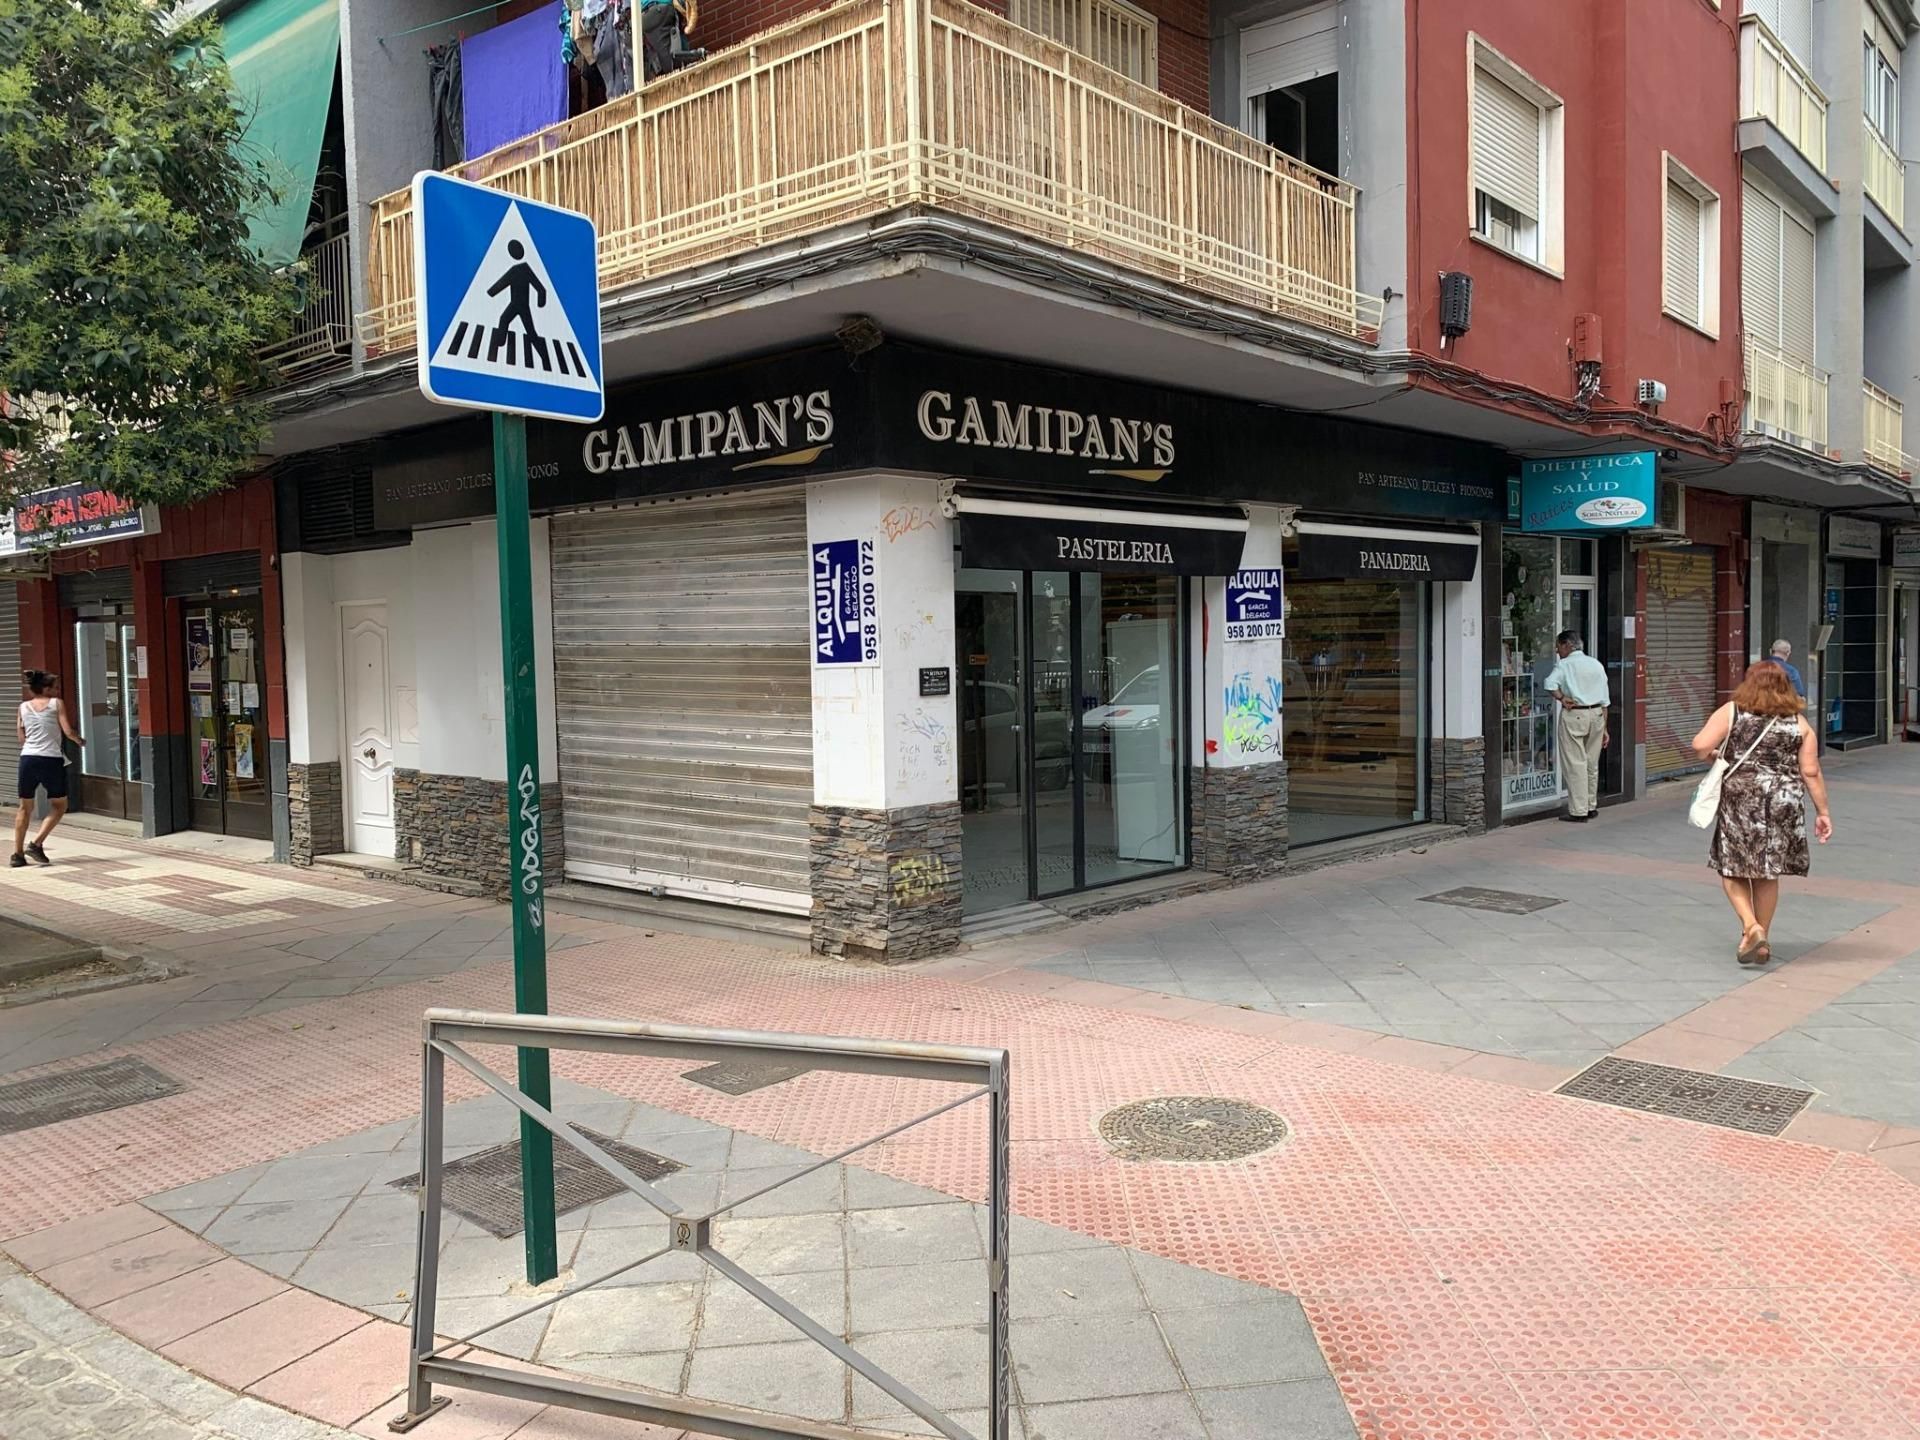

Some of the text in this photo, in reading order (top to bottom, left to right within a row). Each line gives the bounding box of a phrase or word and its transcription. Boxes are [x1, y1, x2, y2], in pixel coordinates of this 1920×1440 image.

[1531, 456, 1644, 473] DIETETICA
[455, 472, 492, 492] DULCES
[1358, 472, 1375, 485] PAN
[1580, 471, 1592, 481] Y
[1552, 481, 1620, 494] SALUD
[1057, 536, 1175, 564] PASTELERIA
[1359, 550, 1431, 571] PANADERIA
[1228, 571, 1279, 590] ALQUILA
[844, 570, 852, 615] GARCIA
[850, 565, 859, 619] DELGADO
[861, 540, 877, 660] 958 200 072
[815, 547, 834, 657] ALQUILA
[1247, 603, 1269, 611] GARCIA
[1246, 611, 1271, 619] DELGADO
[1227, 623, 1282, 639] 958 200 072
[1510, 772, 1557, 794] CARTILOGEN
